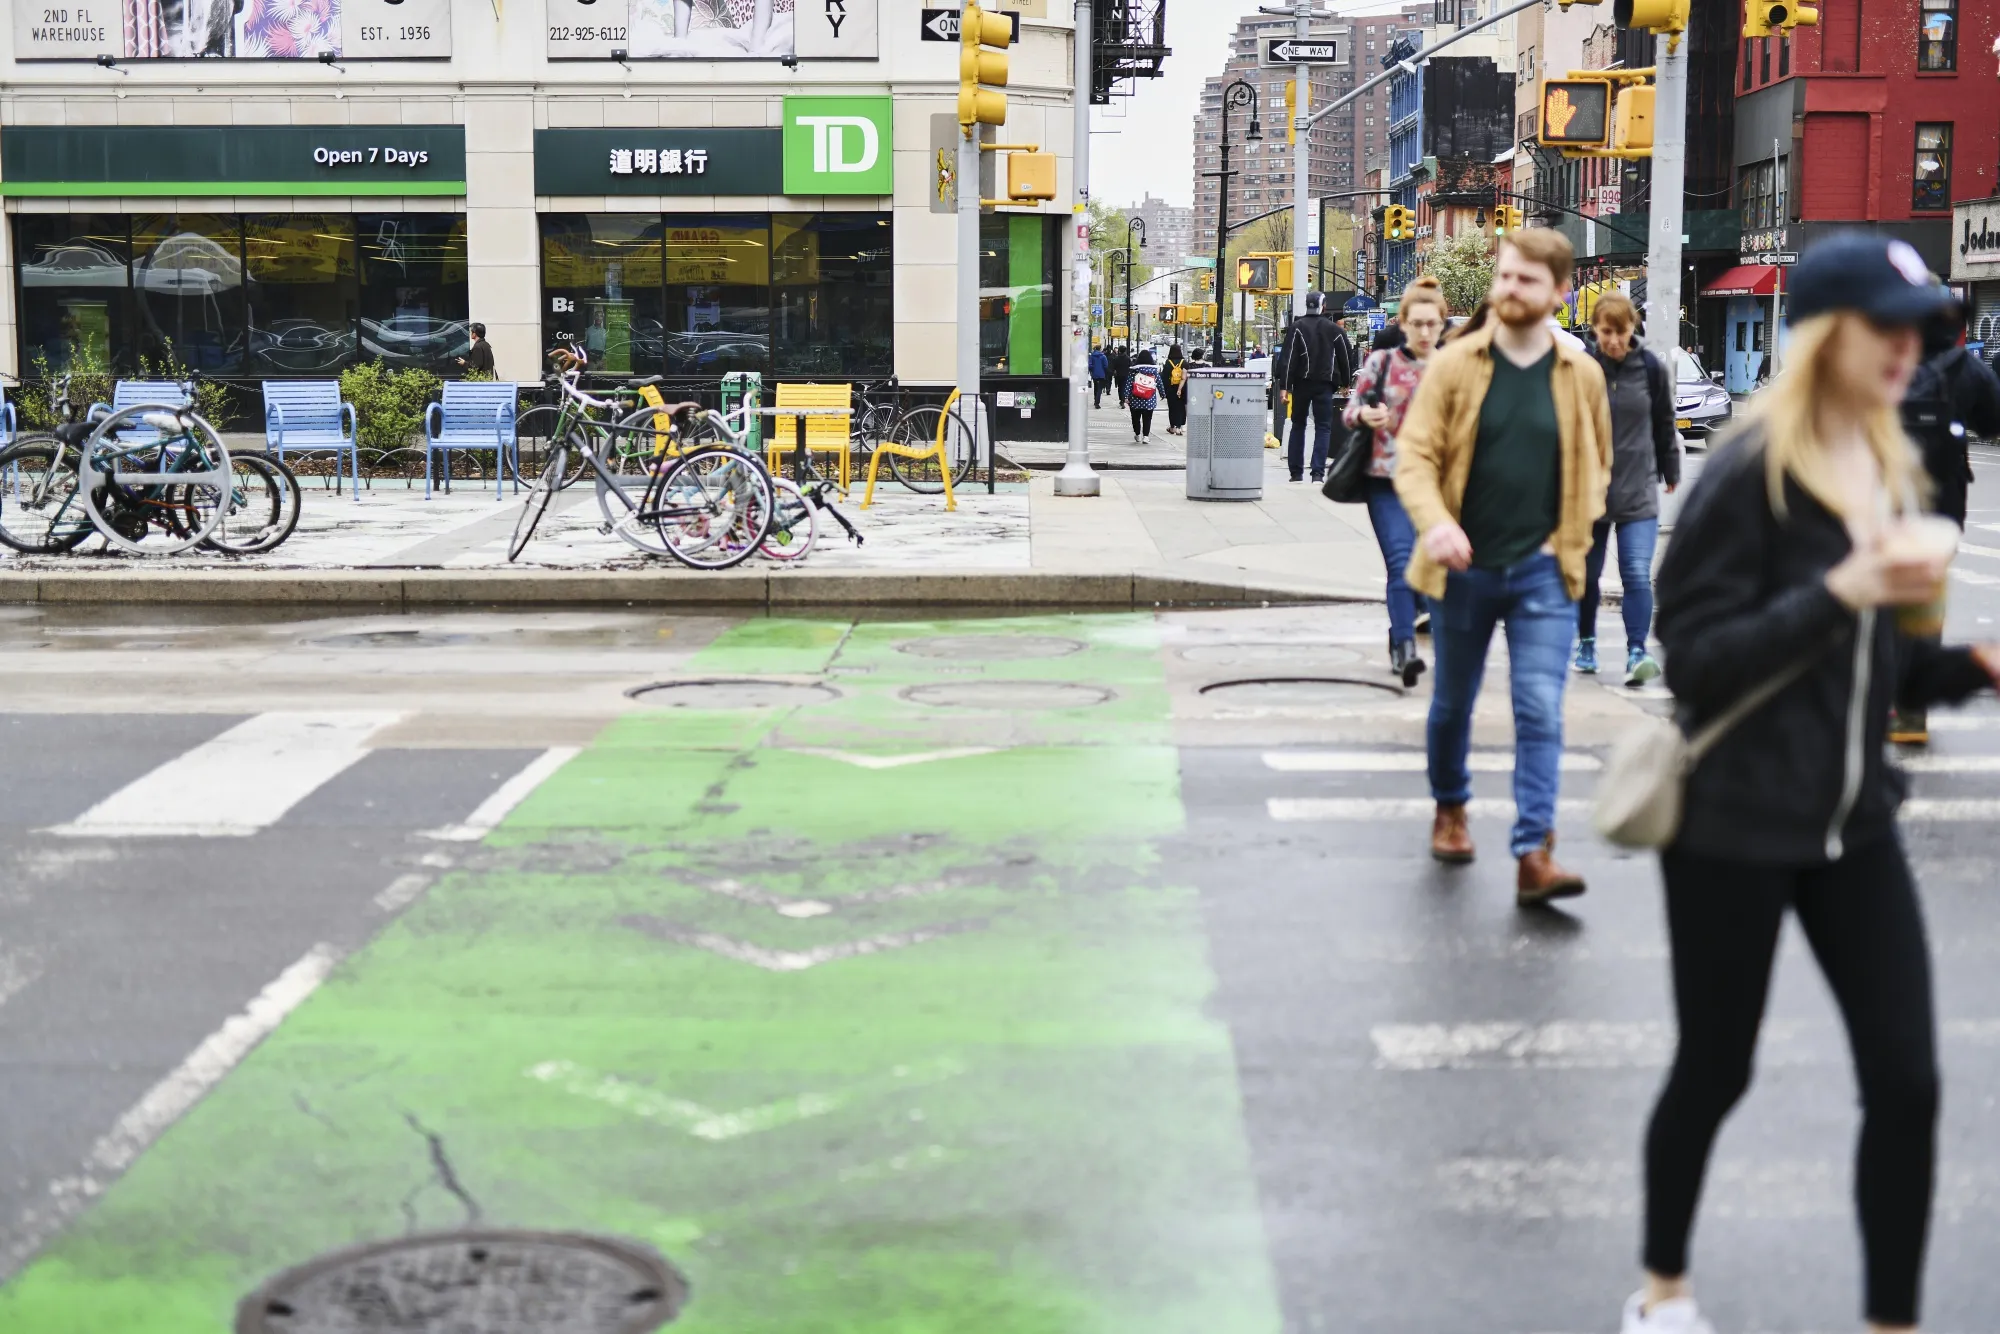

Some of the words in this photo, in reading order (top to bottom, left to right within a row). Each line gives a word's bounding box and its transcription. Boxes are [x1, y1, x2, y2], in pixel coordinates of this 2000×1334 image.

[44, 10, 68, 23] 2ND
[78, 10, 93, 23] FL
[939, 19, 960, 32] ON
[32, 28, 105, 42] WAREHOUSE
[361, 27, 390, 41] EST.
[400, 26, 431, 40] 1936
[549, 26, 627, 41] 212-925-6112
[1281, 46, 1300, 56] ONE
[1309, 46, 1329, 56] WAY
[795, 115, 879, 173] TD
[313, 147, 363, 167] Open
[368, 148, 379, 163] 7
[384, 147, 429, 167] Days
[609, 148, 708, 174] 道明銀行
